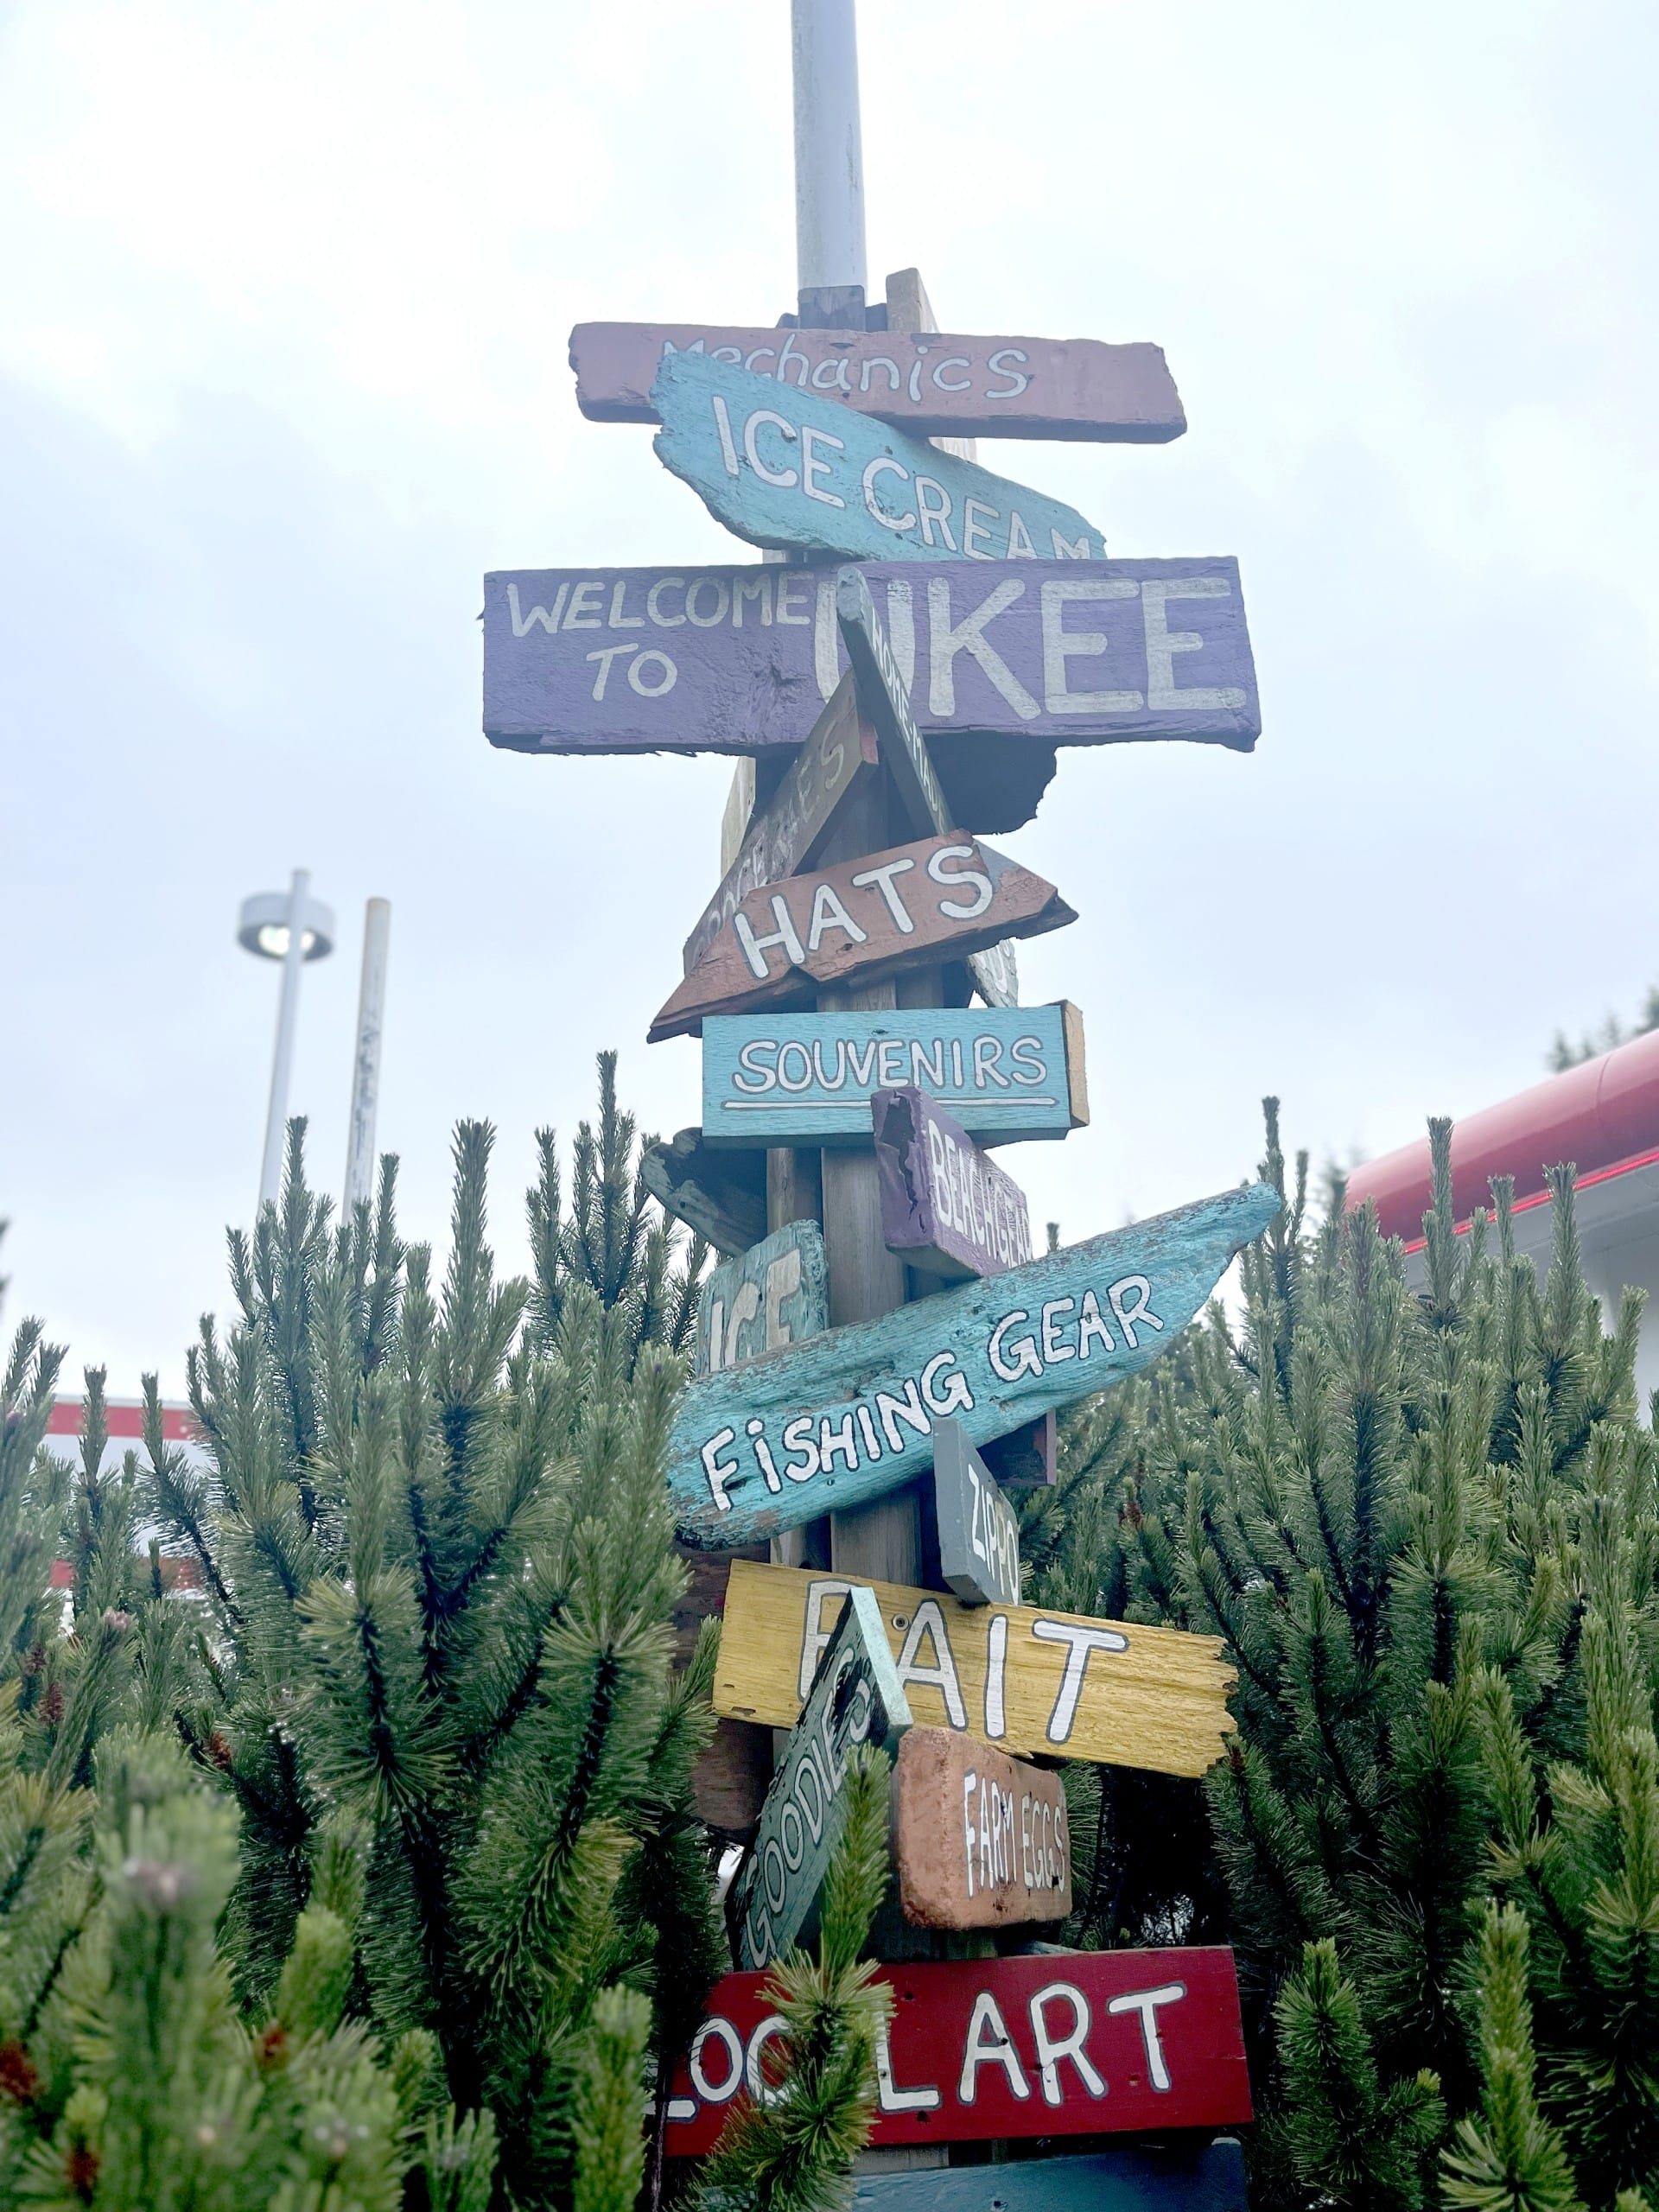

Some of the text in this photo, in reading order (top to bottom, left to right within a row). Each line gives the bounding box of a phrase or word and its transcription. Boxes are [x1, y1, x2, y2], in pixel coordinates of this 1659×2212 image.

[712, 394, 1091, 561] ICE CREAM
[506, 570, 814, 638] WELCOME
[586, 642, 678, 702] TO
[733, 844, 995, 980] HATS
[732, 1035, 1048, 1095] SOUVENIRS
[928, 1119, 997, 1262] BEACH
[988, 1273, 1165, 1383] GEAR
[968, 1463, 1020, 1606] ZIPPO
[745, 1645, 872, 1971] GOODIES
[963, 1770, 1066, 1898] FARM EGGS
[643, 1982, 1187, 2119] OCL ART
